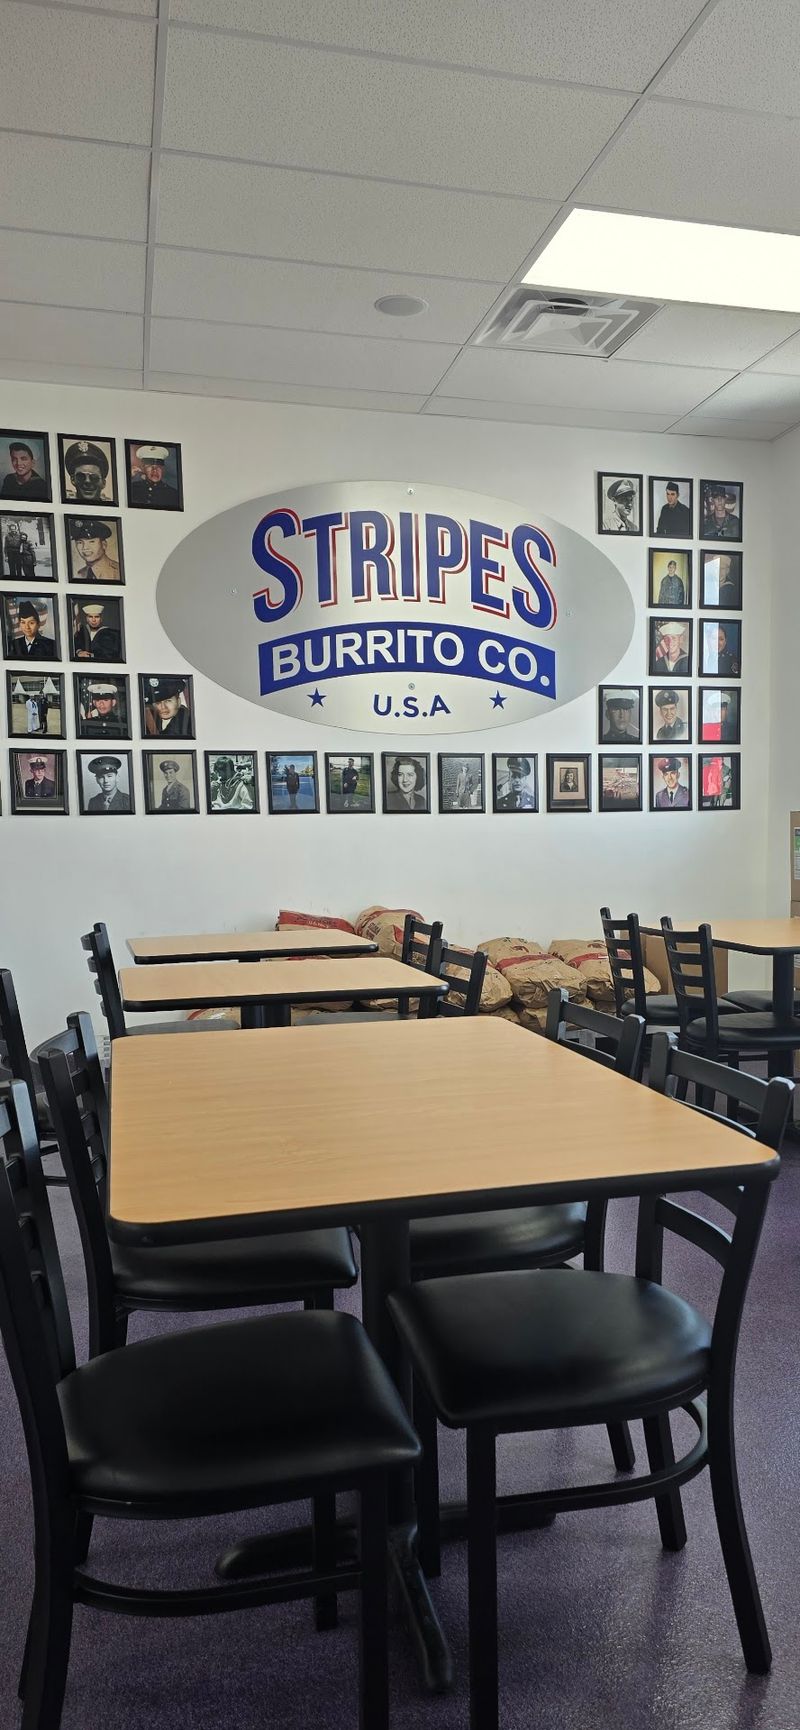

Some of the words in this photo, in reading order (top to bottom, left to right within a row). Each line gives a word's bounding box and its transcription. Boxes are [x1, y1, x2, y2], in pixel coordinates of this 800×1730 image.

[252, 508, 557, 631] STRIPES
[272, 629, 464, 681] BURRITO
[478, 639, 550, 687] CO.
[373, 694, 451, 718] U.S.A
